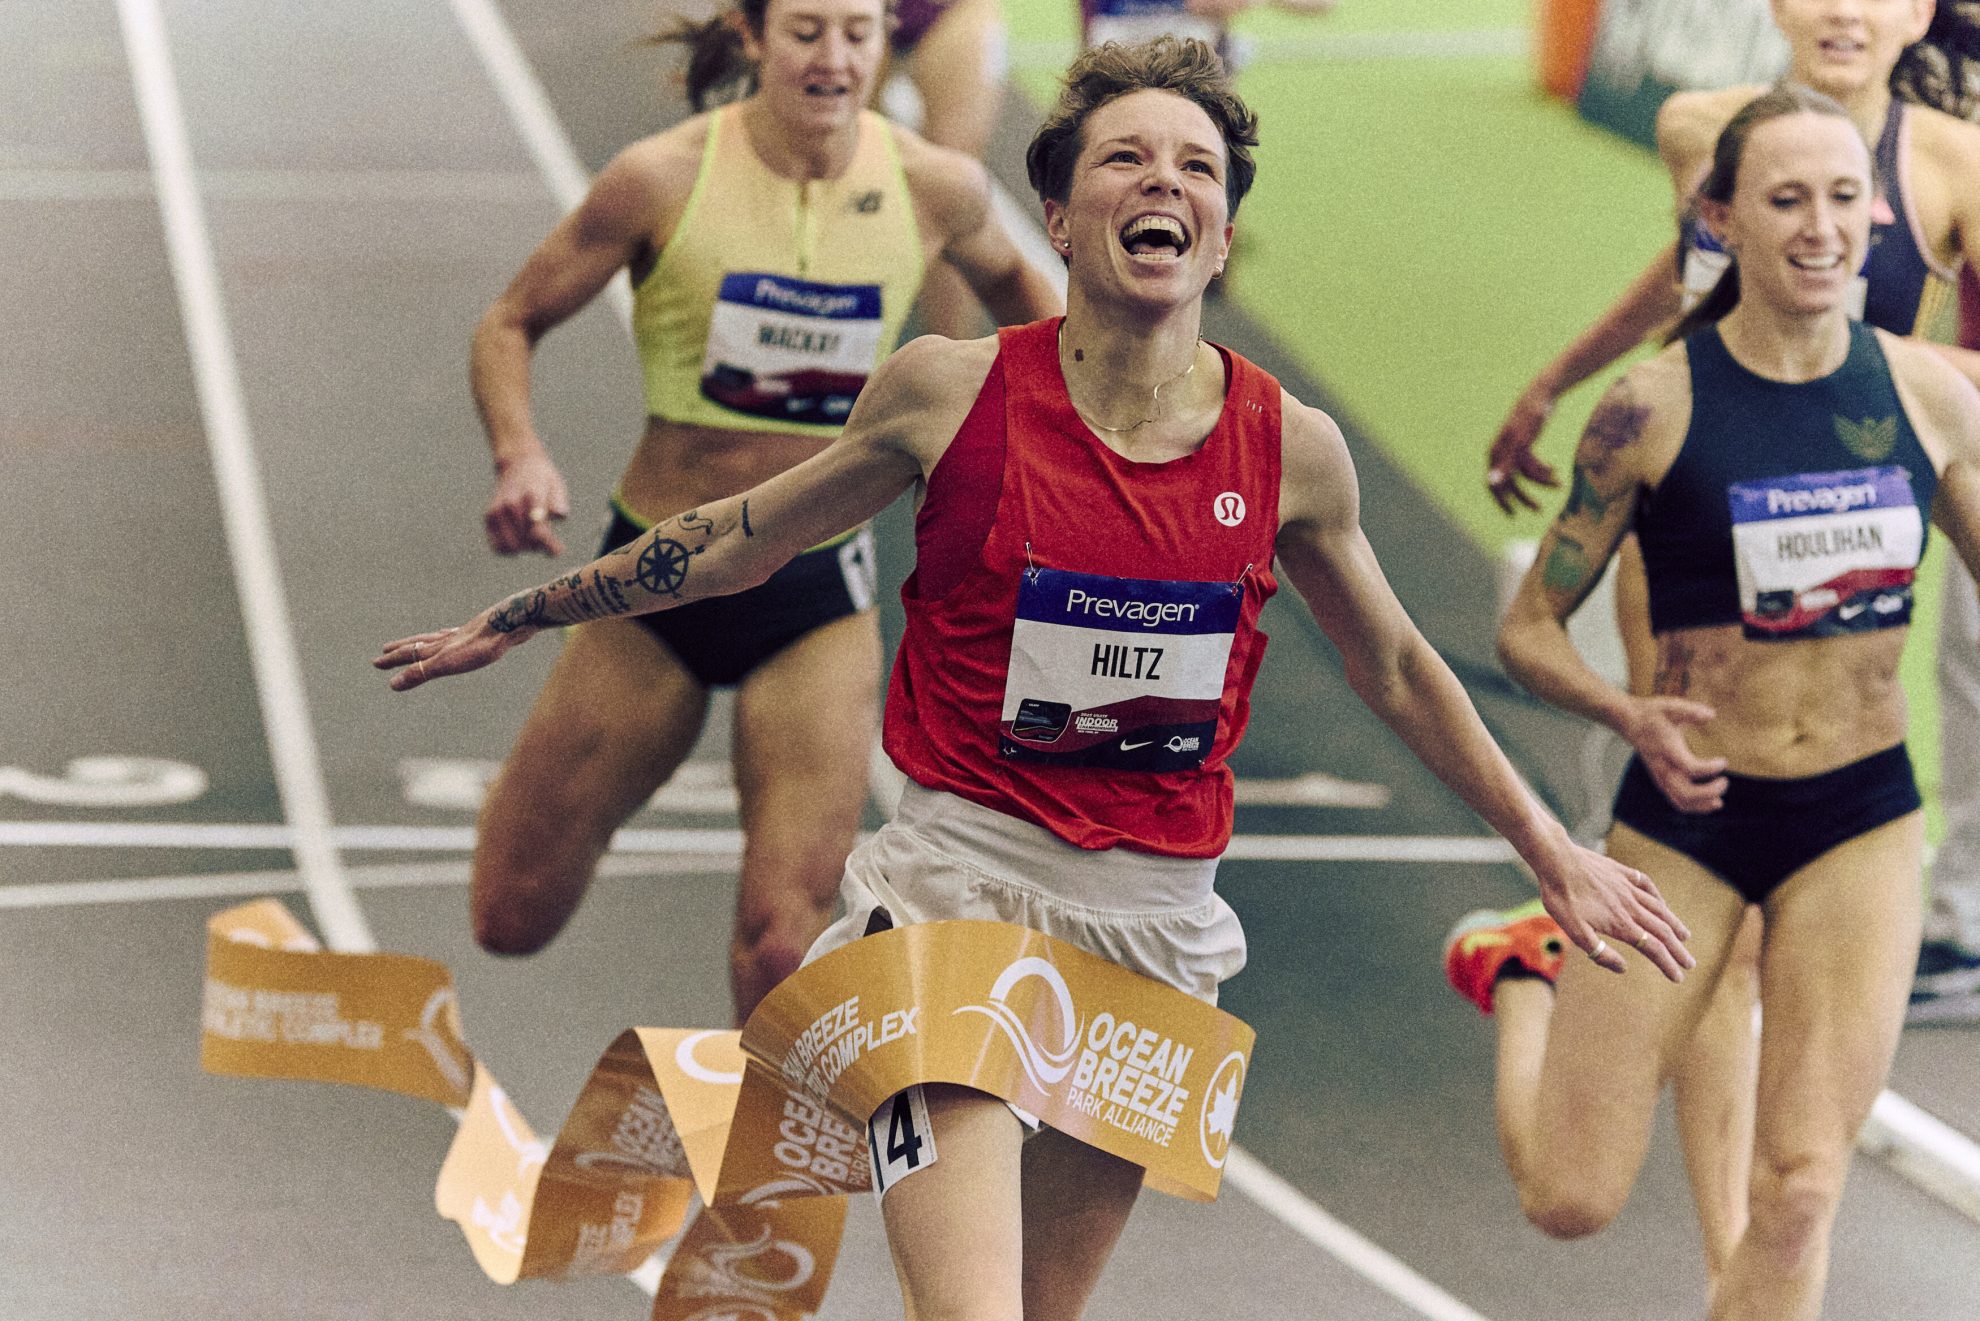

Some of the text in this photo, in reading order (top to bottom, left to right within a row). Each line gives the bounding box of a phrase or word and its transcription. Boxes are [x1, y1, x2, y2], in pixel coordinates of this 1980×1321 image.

[1767, 483, 1877, 514] Prevagen
[1777, 525, 1883, 561] HOULIHAN
[1066, 589, 1196, 628] Prevagen
[1091, 643, 1164, 681] HILTZ
[1075, 716, 1119, 729] INDOOR
[794, 995, 859, 1069] BREEZE
[820, 1006, 920, 1084] COMPLEX
[1088, 1012, 1194, 1084] OCEAN
[1071, 1049, 1190, 1127] BREEZE
[1066, 1087, 1176, 1148] PARK ALLIANCE
